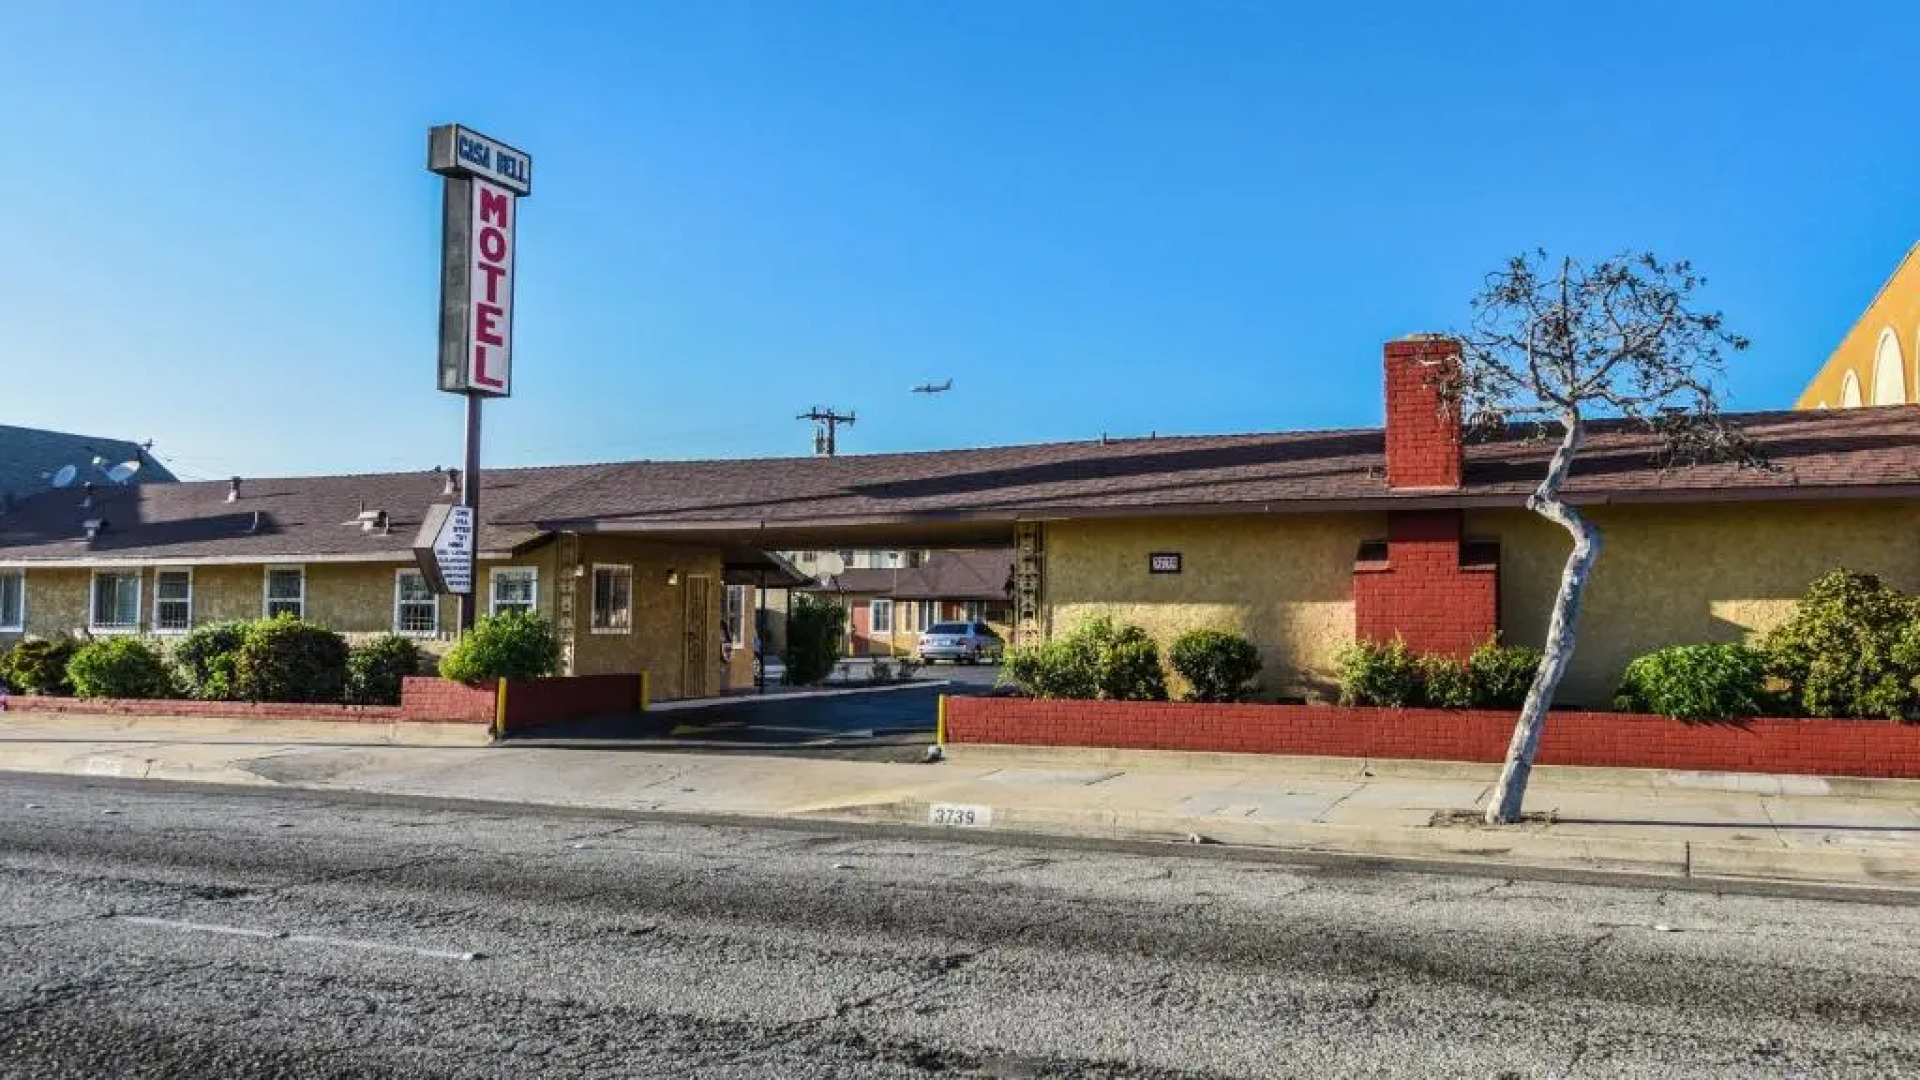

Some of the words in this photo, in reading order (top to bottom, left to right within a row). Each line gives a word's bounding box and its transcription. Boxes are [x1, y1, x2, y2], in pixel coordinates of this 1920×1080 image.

[460, 135, 490, 169] CASA
[497, 150, 527, 183] BELL
[475, 187, 507, 388] MOTEL
[935, 809, 975, 824] 3739
